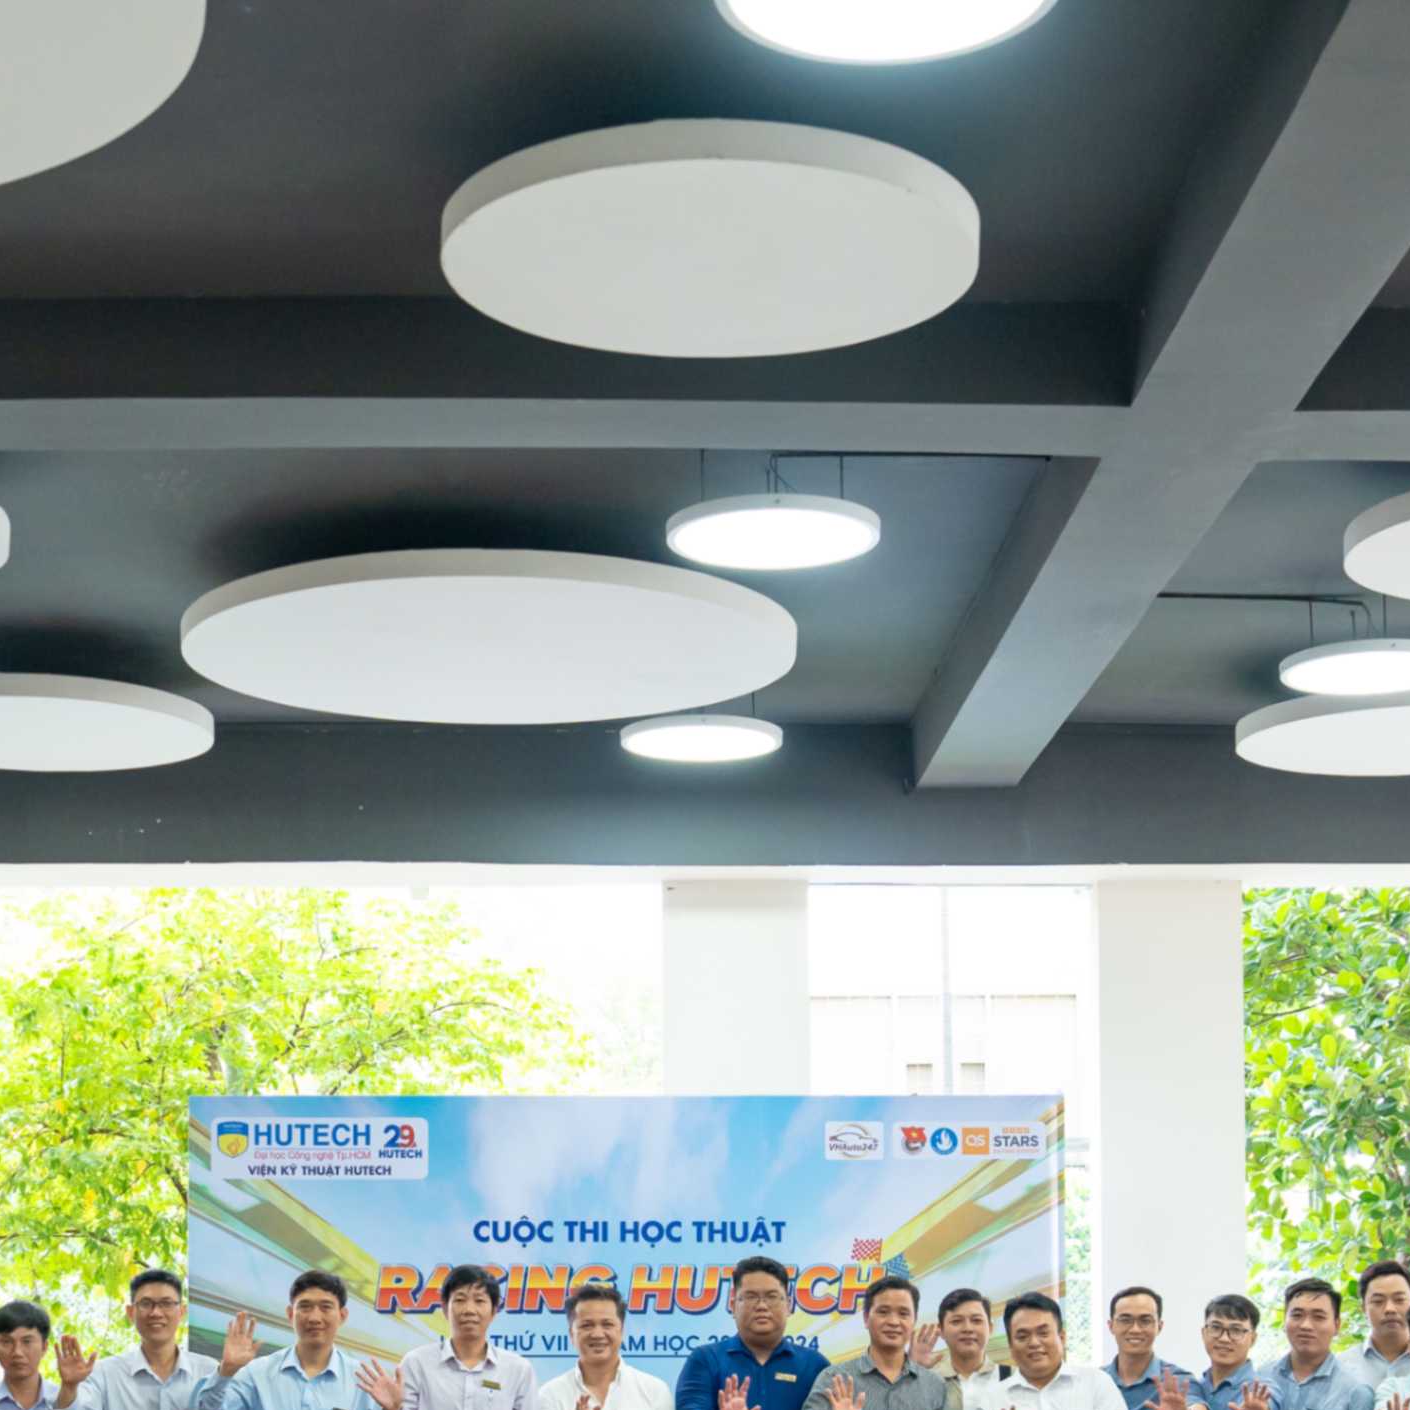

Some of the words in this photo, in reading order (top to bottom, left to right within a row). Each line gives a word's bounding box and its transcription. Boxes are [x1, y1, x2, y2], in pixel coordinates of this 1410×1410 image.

[254, 1123, 371, 1146] HUTECH
[993, 1135, 1039, 1148] STARS
[378, 1149, 422, 1159] HUTECH
[248, 1164, 277, 1178] VIỆN
[301, 1164, 340, 1178] THUẬT
[344, 1165, 392, 1176] HUTECH
[473, 1215, 554, 1248] CUỘC
[564, 1221, 608, 1243] THI
[620, 1220, 682, 1248] HỌC
[692, 1216, 786, 1247] THUẬT
[491, 1330, 536, 1351] THỨ
[541, 1334, 569, 1351] VII
[653, 1334, 700, 1356] HỌC
